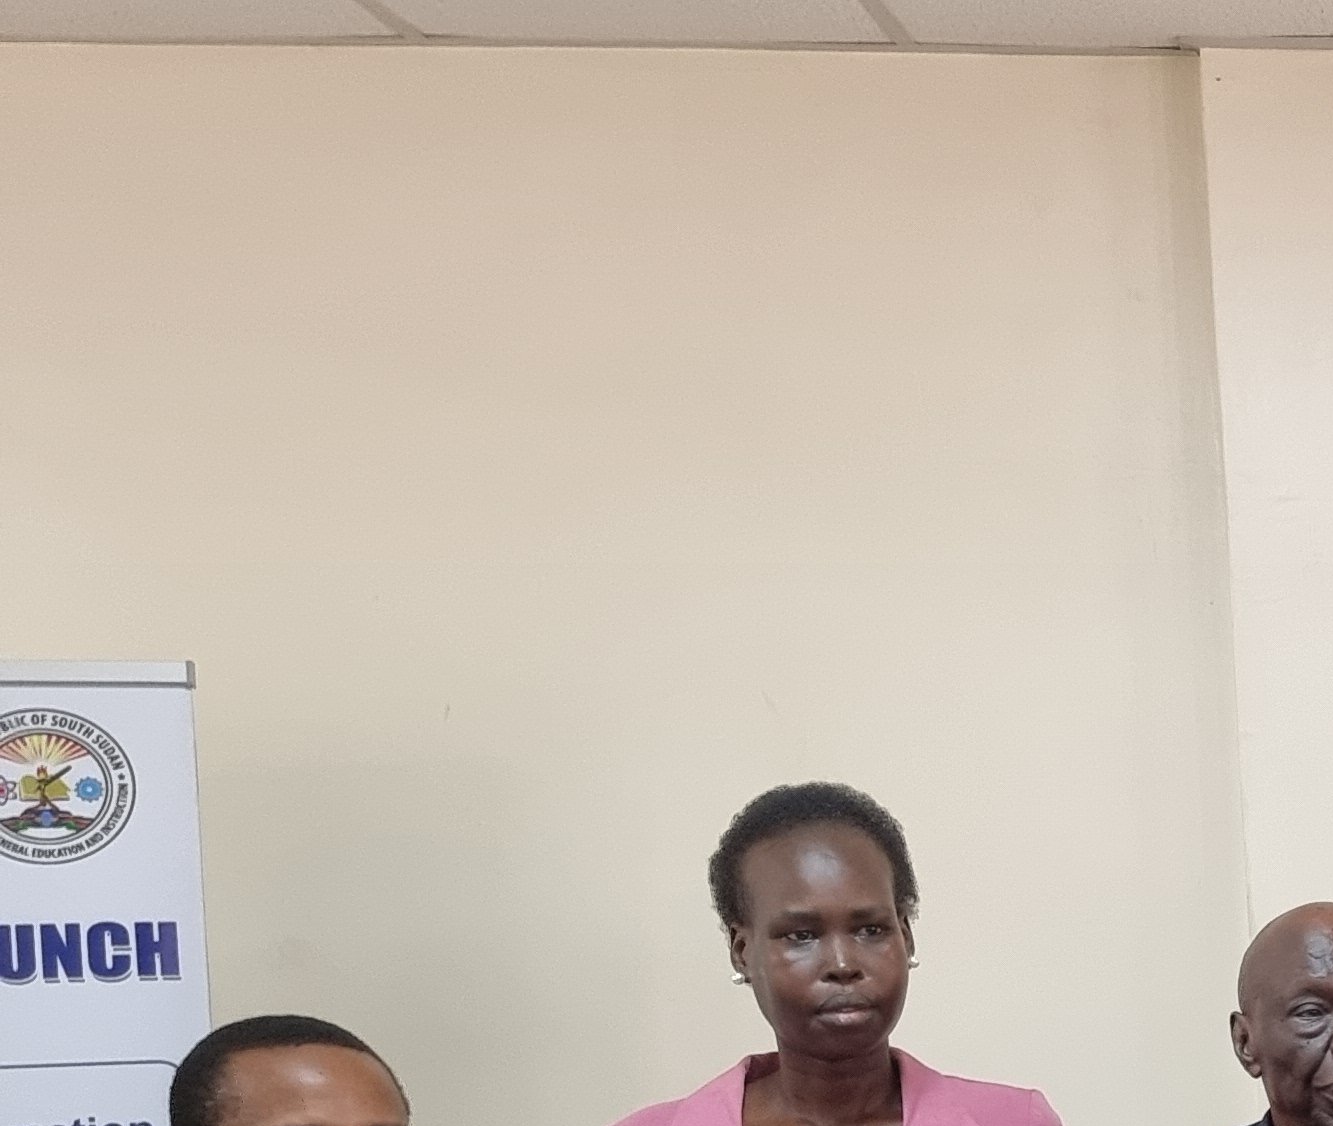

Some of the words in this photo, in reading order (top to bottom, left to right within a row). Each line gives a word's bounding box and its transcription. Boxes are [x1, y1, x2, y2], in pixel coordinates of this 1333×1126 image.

[0, 714, 29, 732] BLIC
[31, 713, 47, 726] OF
[51, 715, 95, 739] SOUTH
[92, 734, 126, 771] SUDAN
[32, 843, 86, 859] EDUCATION
[85, 831, 105, 849] AND
